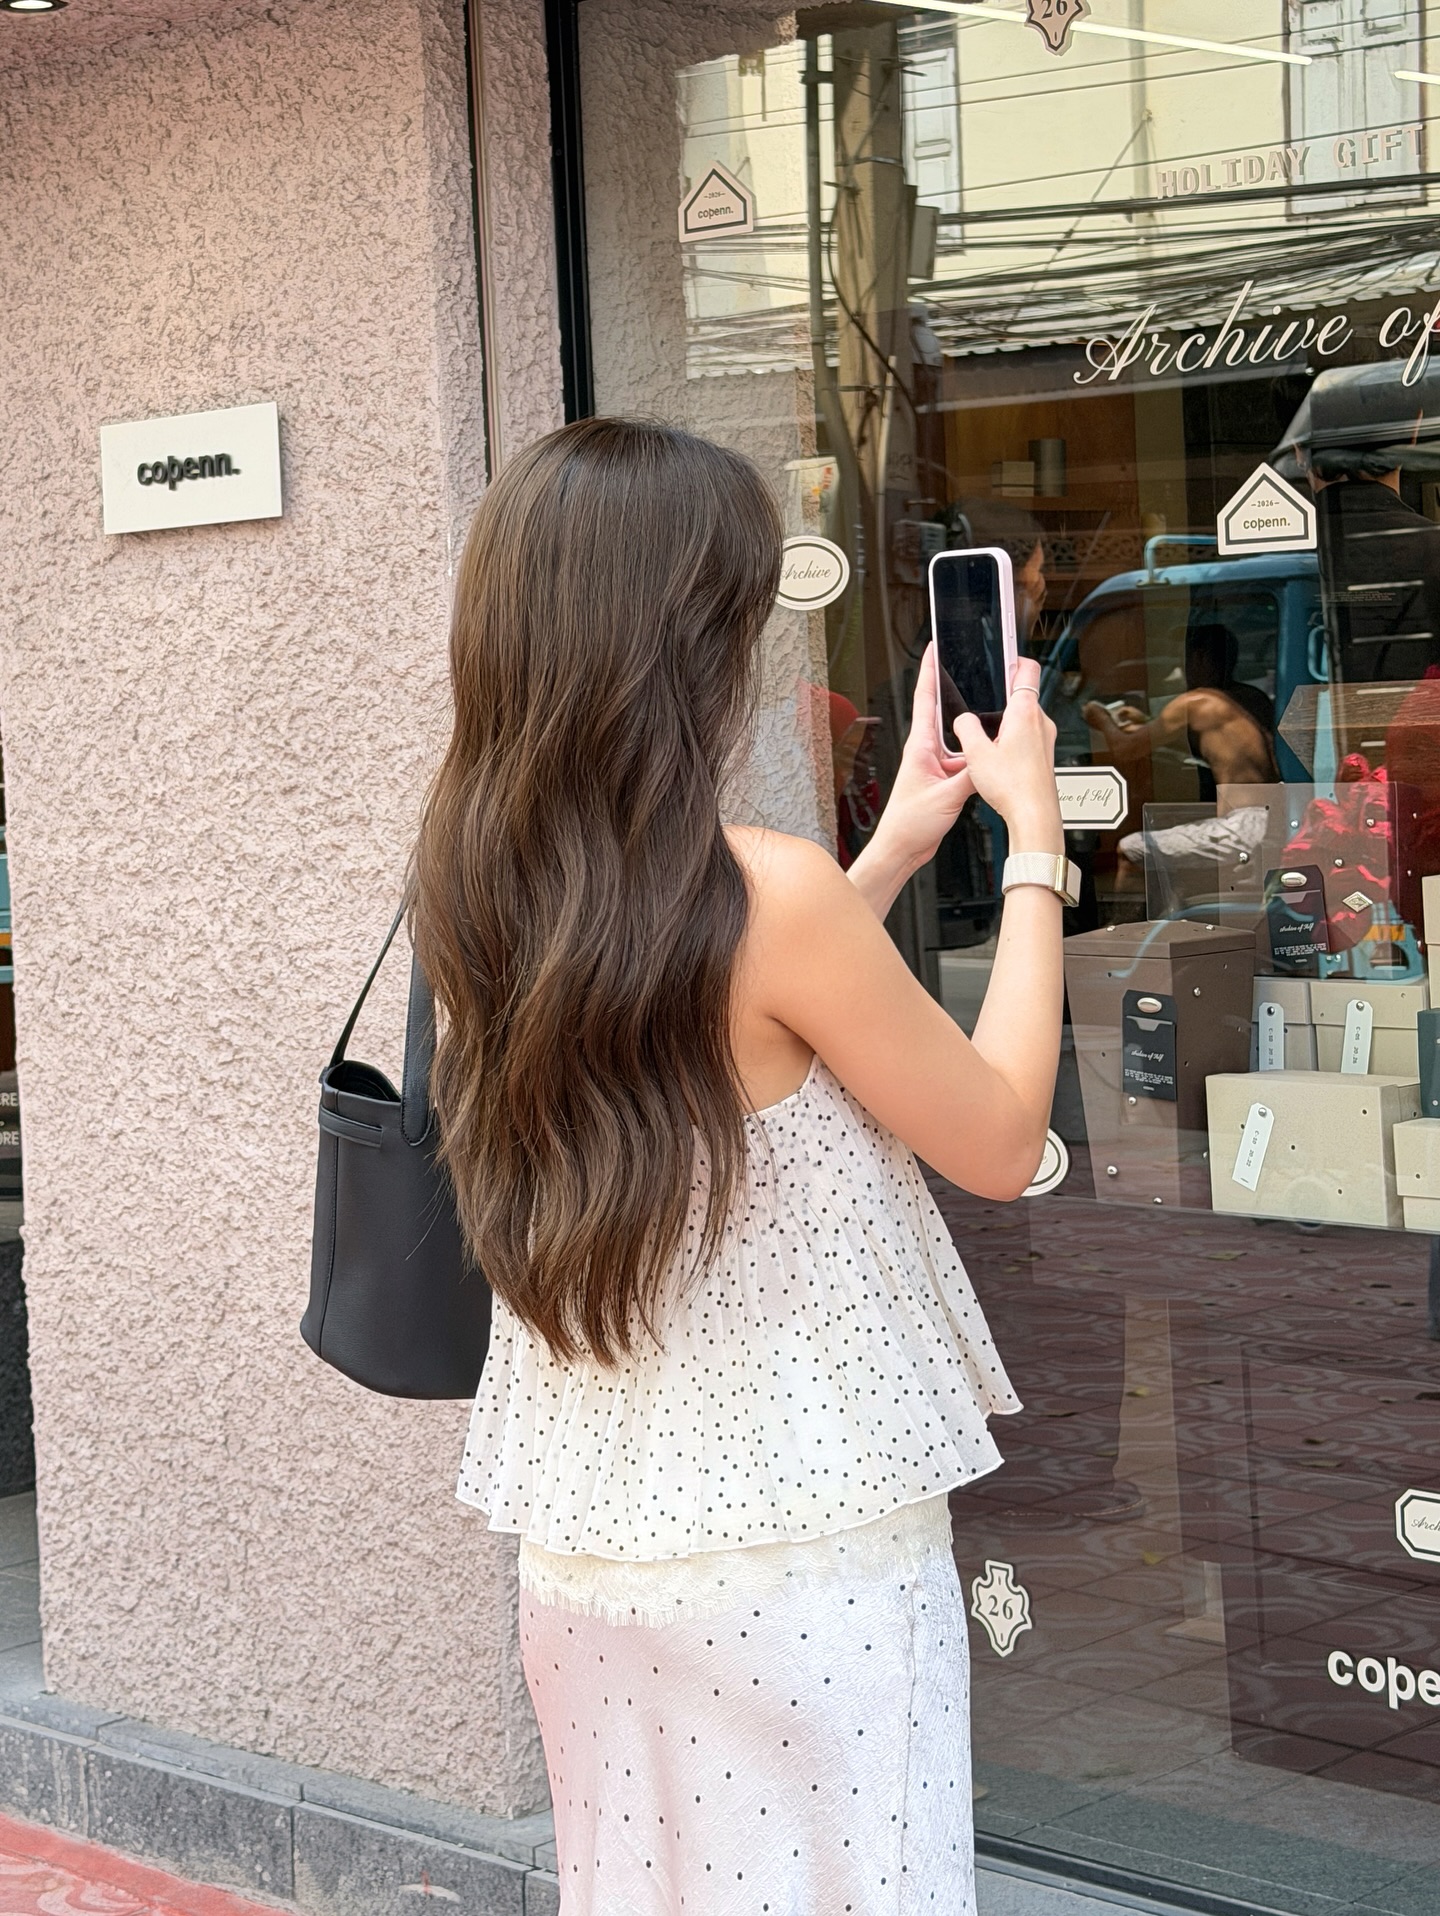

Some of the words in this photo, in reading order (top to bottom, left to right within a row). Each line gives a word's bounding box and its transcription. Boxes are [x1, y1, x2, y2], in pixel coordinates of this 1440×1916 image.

[1157, 147, 1308, 199] HOLIDAY
[1333, 124, 1423, 168] GIFT
[1073, 280, 1354, 385] Archive
[1076, 788, 1090, 808] of
[1090, 788, 1114, 808] Self
[987, 1594, 1014, 1620] 26
